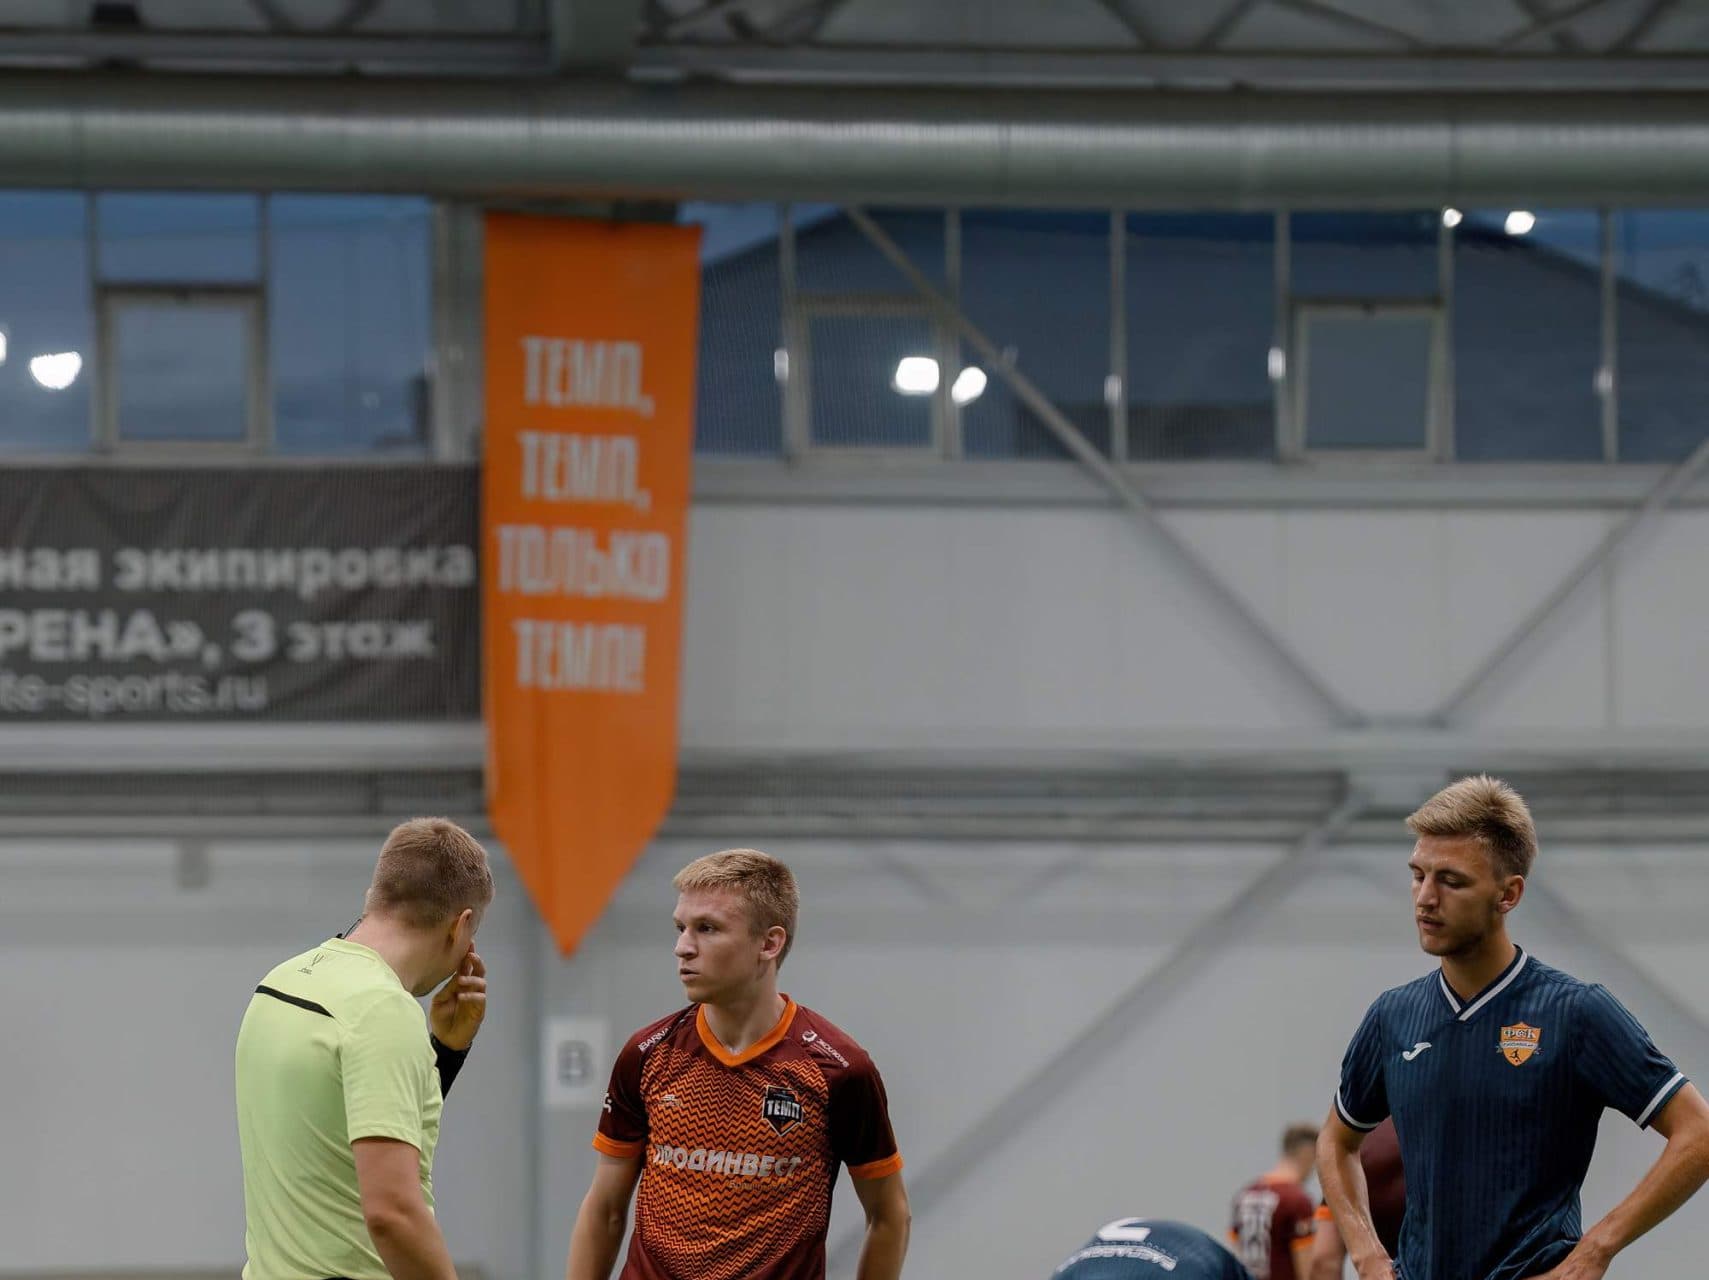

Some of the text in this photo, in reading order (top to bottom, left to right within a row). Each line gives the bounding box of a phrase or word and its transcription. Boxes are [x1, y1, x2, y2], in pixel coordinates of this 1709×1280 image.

[522, 335, 655, 418] ТЕМП,
[518, 430, 651, 514] ТЕМП,
[113, 545, 474, 602] экипировка
[496, 523, 669, 602] ТОЛЬКО
[231, 610, 276, 662] 3
[287, 621, 438, 662] этаж
[511, 618, 646, 692] ТЕМП!
[766, 1100, 801, 1120] ТЕМП
